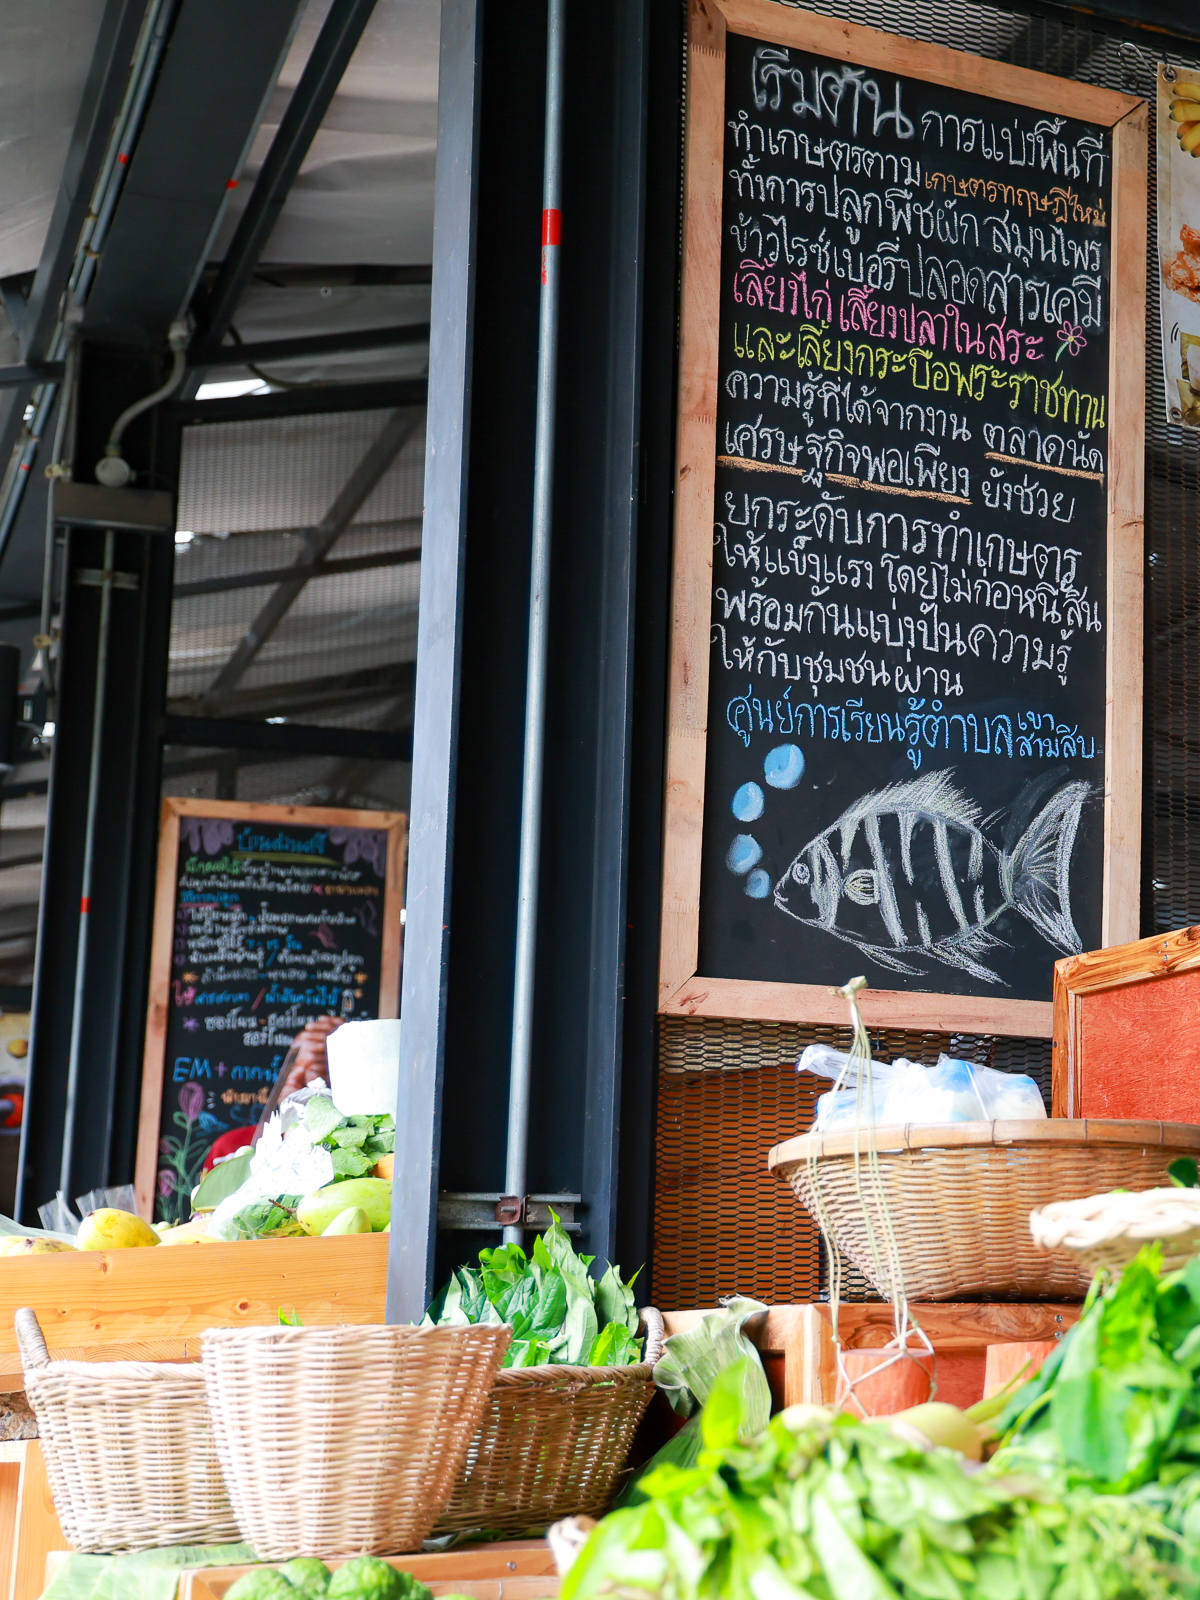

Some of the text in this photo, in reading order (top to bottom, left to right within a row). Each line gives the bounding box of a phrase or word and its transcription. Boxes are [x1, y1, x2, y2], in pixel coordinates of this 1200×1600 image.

[728, 110, 921, 187] ทำเกษตรตาม
[982, 209, 1102, 272] สมุนไพร
[724, 413, 1076, 523] เศรษฐกิจพอเพียง ยังช่วย
[982, 422, 1104, 473] ตลาดนัด
[724, 490, 1083, 585] ยกระดับการทำเกษตร
[709, 623, 964, 698] ให้กับชุมชนผ่าน
[726, 683, 1014, 771] ศูนย์การเรียนรู้ตำบล
[173, 1056, 213, 1082] EM
